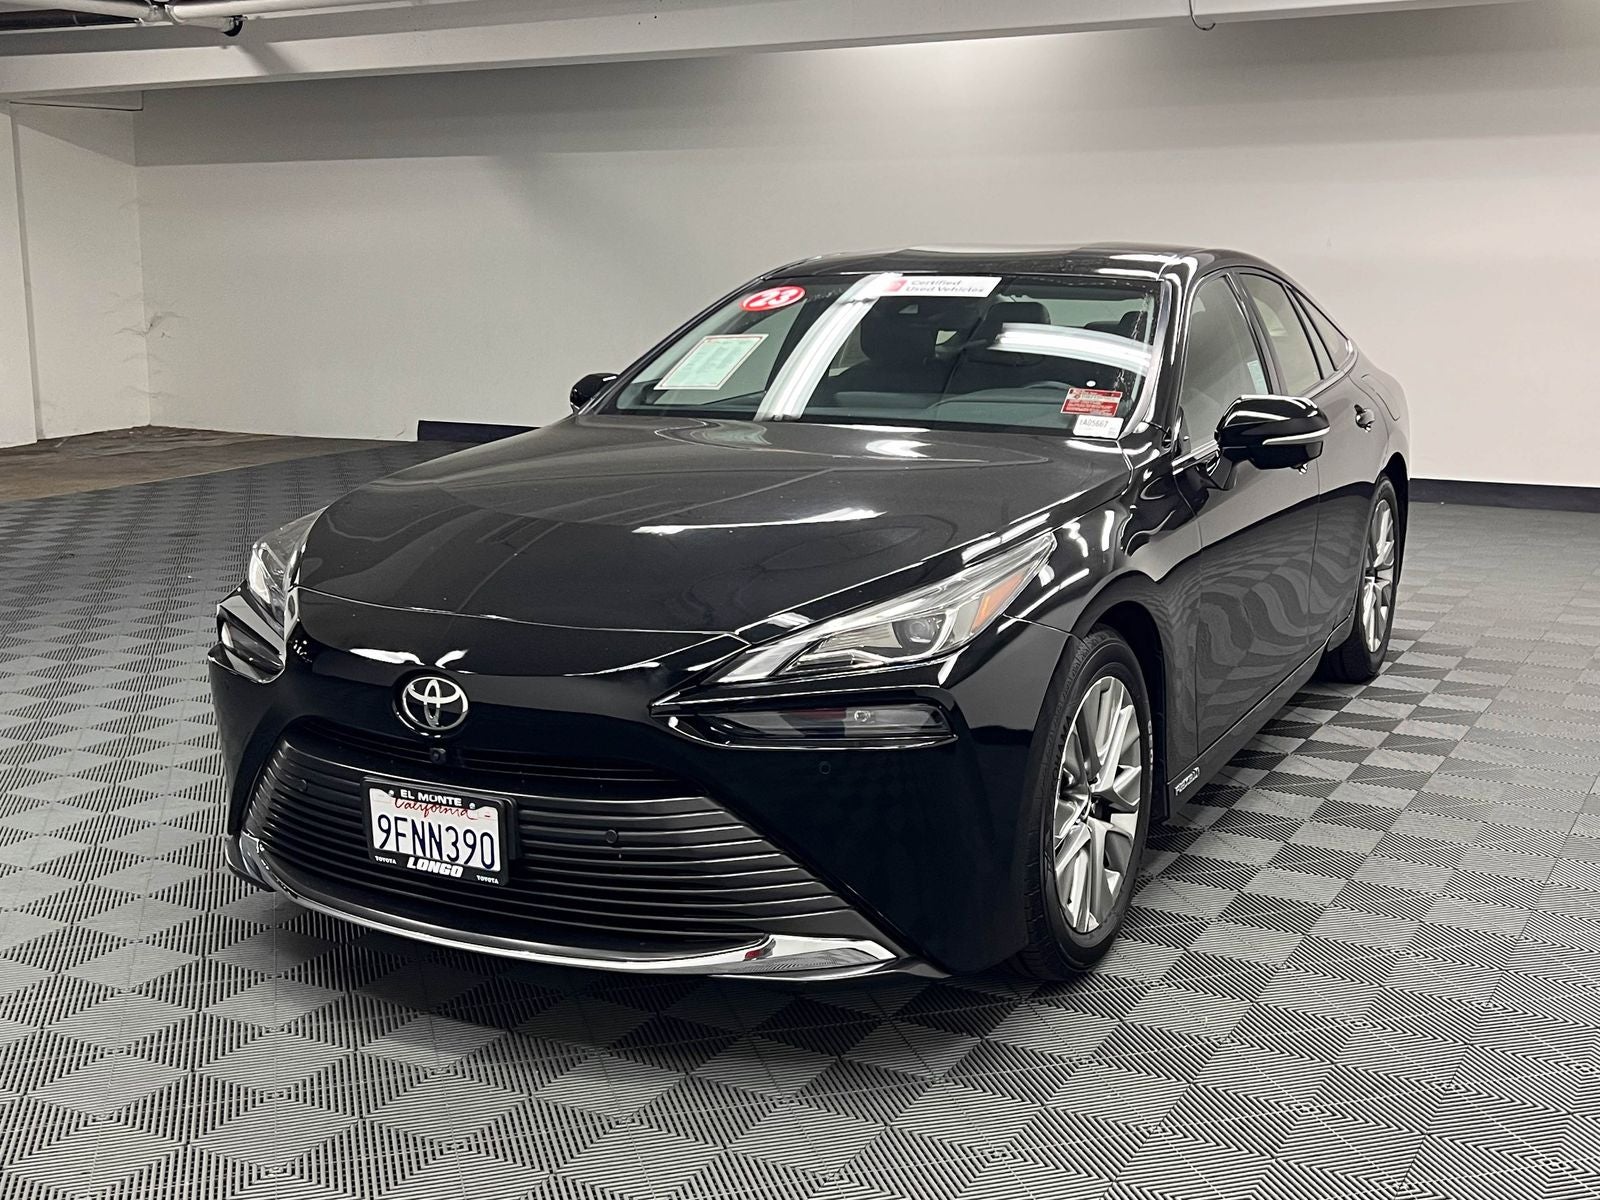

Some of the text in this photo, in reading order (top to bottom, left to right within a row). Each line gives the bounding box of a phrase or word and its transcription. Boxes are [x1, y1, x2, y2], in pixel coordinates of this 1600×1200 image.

[748, 289, 799, 307] 23
[400, 789, 463, 807] EL MONTE
[377, 814, 495, 870] 9FNN390
[375, 855, 397, 865] TOYOTA
[406, 856, 464, 878] LONGO
[476, 874, 499, 885] TOYOTA
